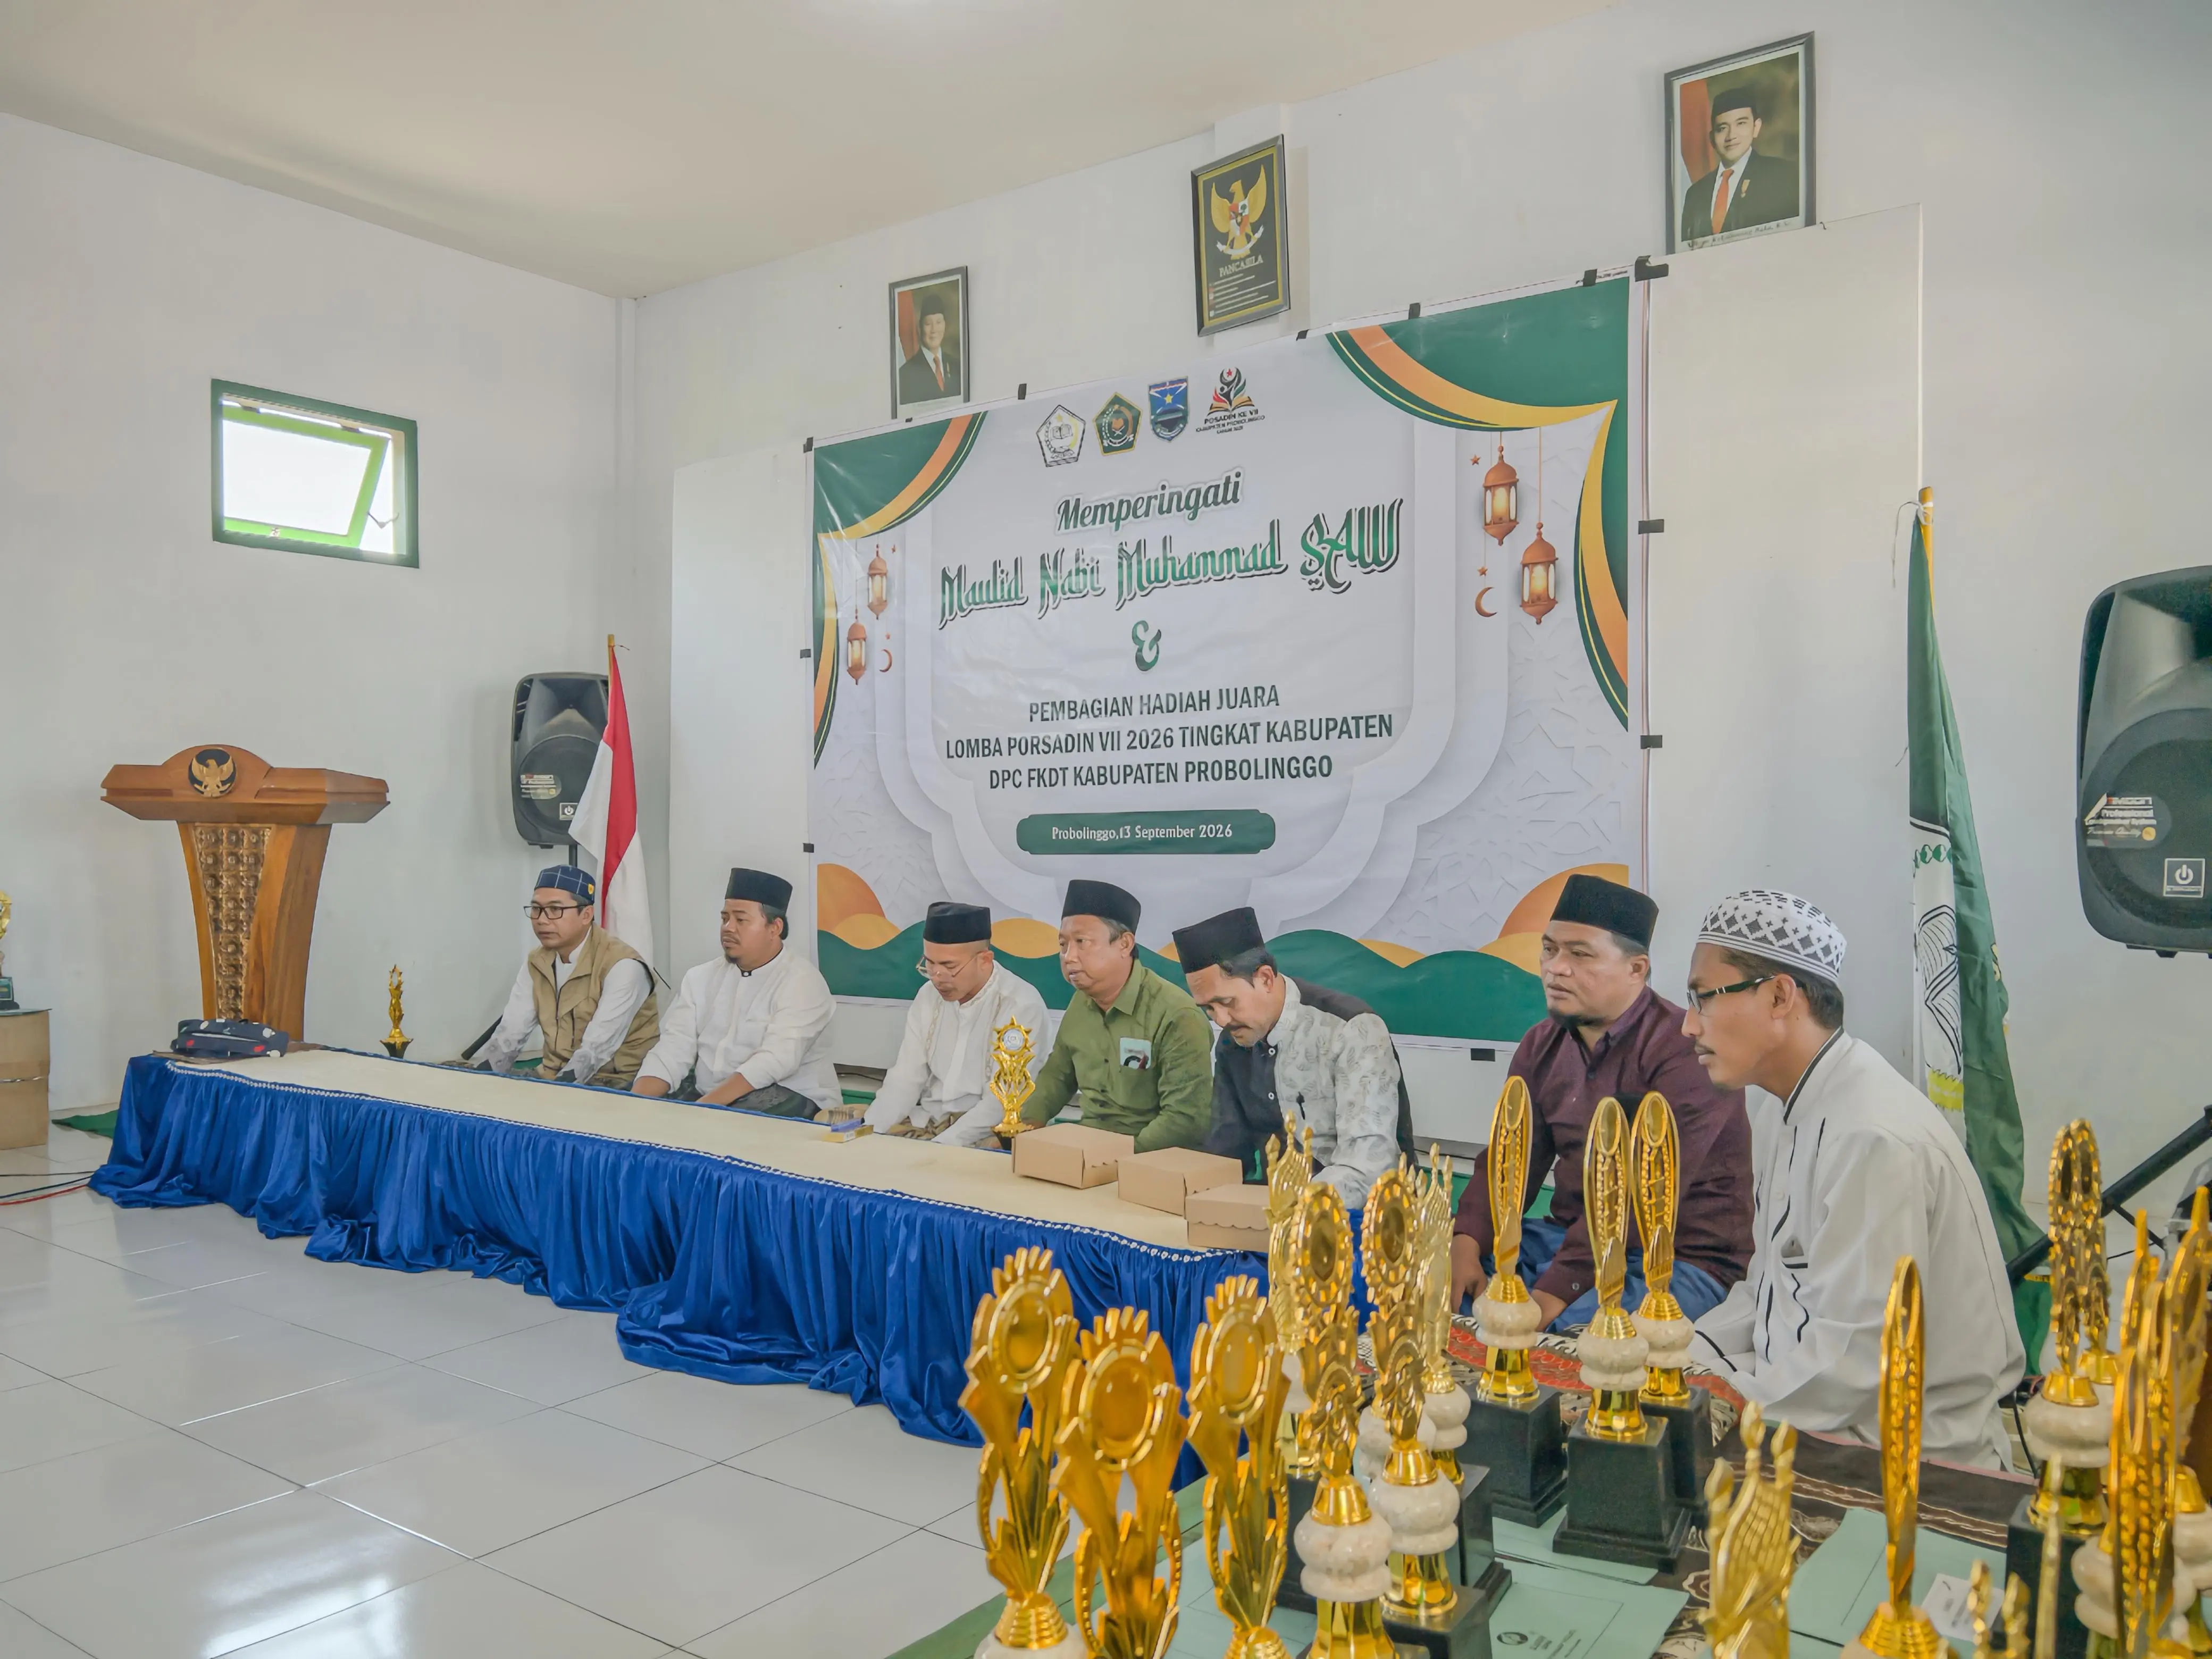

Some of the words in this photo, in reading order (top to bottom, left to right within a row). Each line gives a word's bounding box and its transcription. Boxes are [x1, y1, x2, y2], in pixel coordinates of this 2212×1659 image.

[1219, 254, 1263, 277] PANCASILA
[1204, 413, 1236, 425] POSADIN
[1057, 471, 1242, 532] Memperingati
[939, 556, 1028, 630] Maulid
[1037, 547, 1106, 619] Nabi
[1115, 518, 1288, 611] Muhammad
[1300, 498, 1403, 594] SAW
[1132, 620, 1161, 672] &
[1029, 696, 1133, 723] PEMBAGIAN
[1139, 690, 1210, 715] HADIAH
[1217, 684, 1280, 710] JUARA
[946, 737, 1003, 759] LOMBA
[1008, 732, 1094, 756] PORSADIN
[1099, 731, 1120, 751] VII
[1126, 727, 1174, 750] 2026
[1179, 722, 1261, 748] TINGKAT
[1267, 714, 1393, 743] KABUPATEN
[990, 769, 1022, 789] DPC
[1028, 767, 1069, 787] FKDT
[1074, 762, 1178, 786] KABUPATEN
[1185, 755, 1333, 783] PROBOLINGGO
[1135, 825, 1195, 841] September
[1199, 824, 1233, 838] 2026
